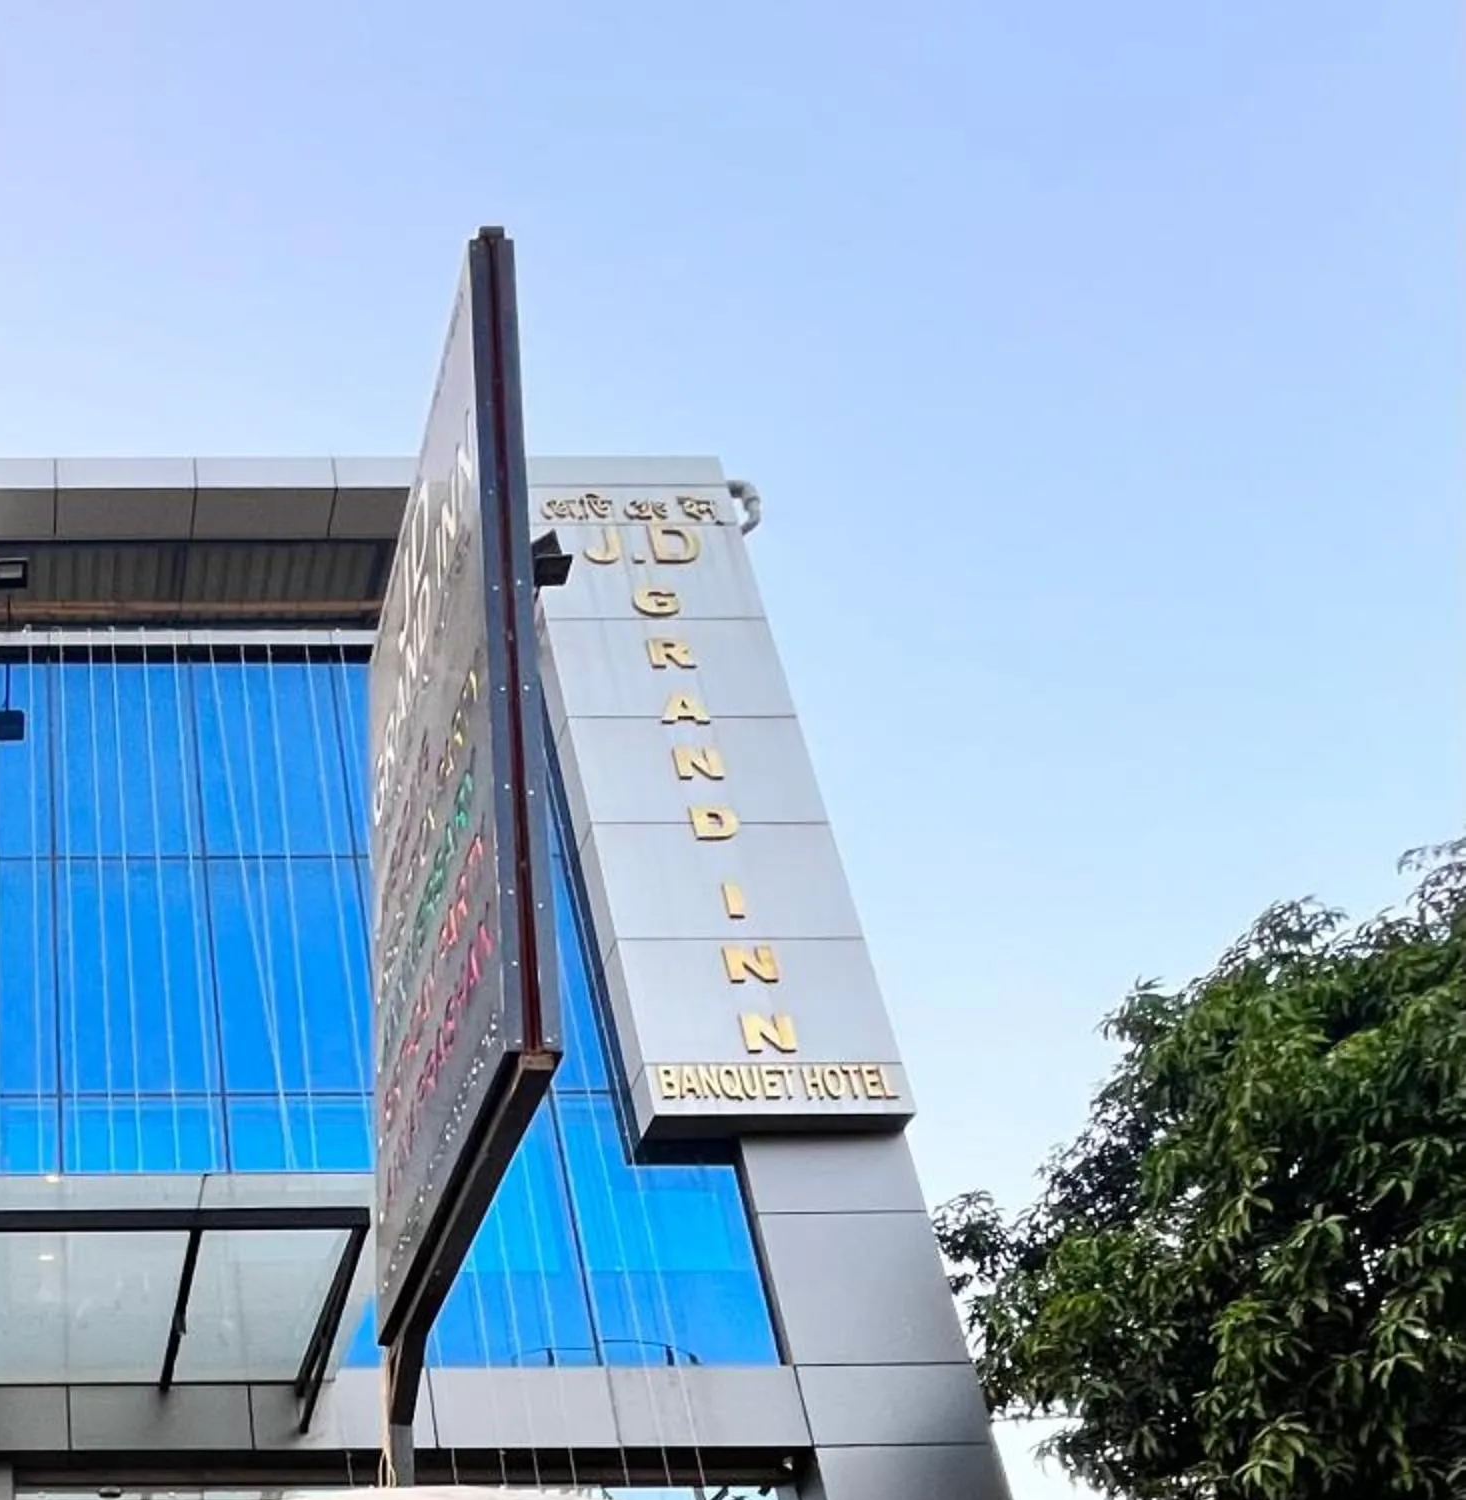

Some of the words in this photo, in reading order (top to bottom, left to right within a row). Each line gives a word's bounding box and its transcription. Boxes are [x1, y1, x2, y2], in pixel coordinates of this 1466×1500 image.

[583, 523, 700, 565] J.D
[632, 586, 741, 841] GRAND
[720, 880, 798, 1054] INN
[658, 1065, 793, 1101] BANQUET
[800, 1066, 901, 1101] HOTEL
